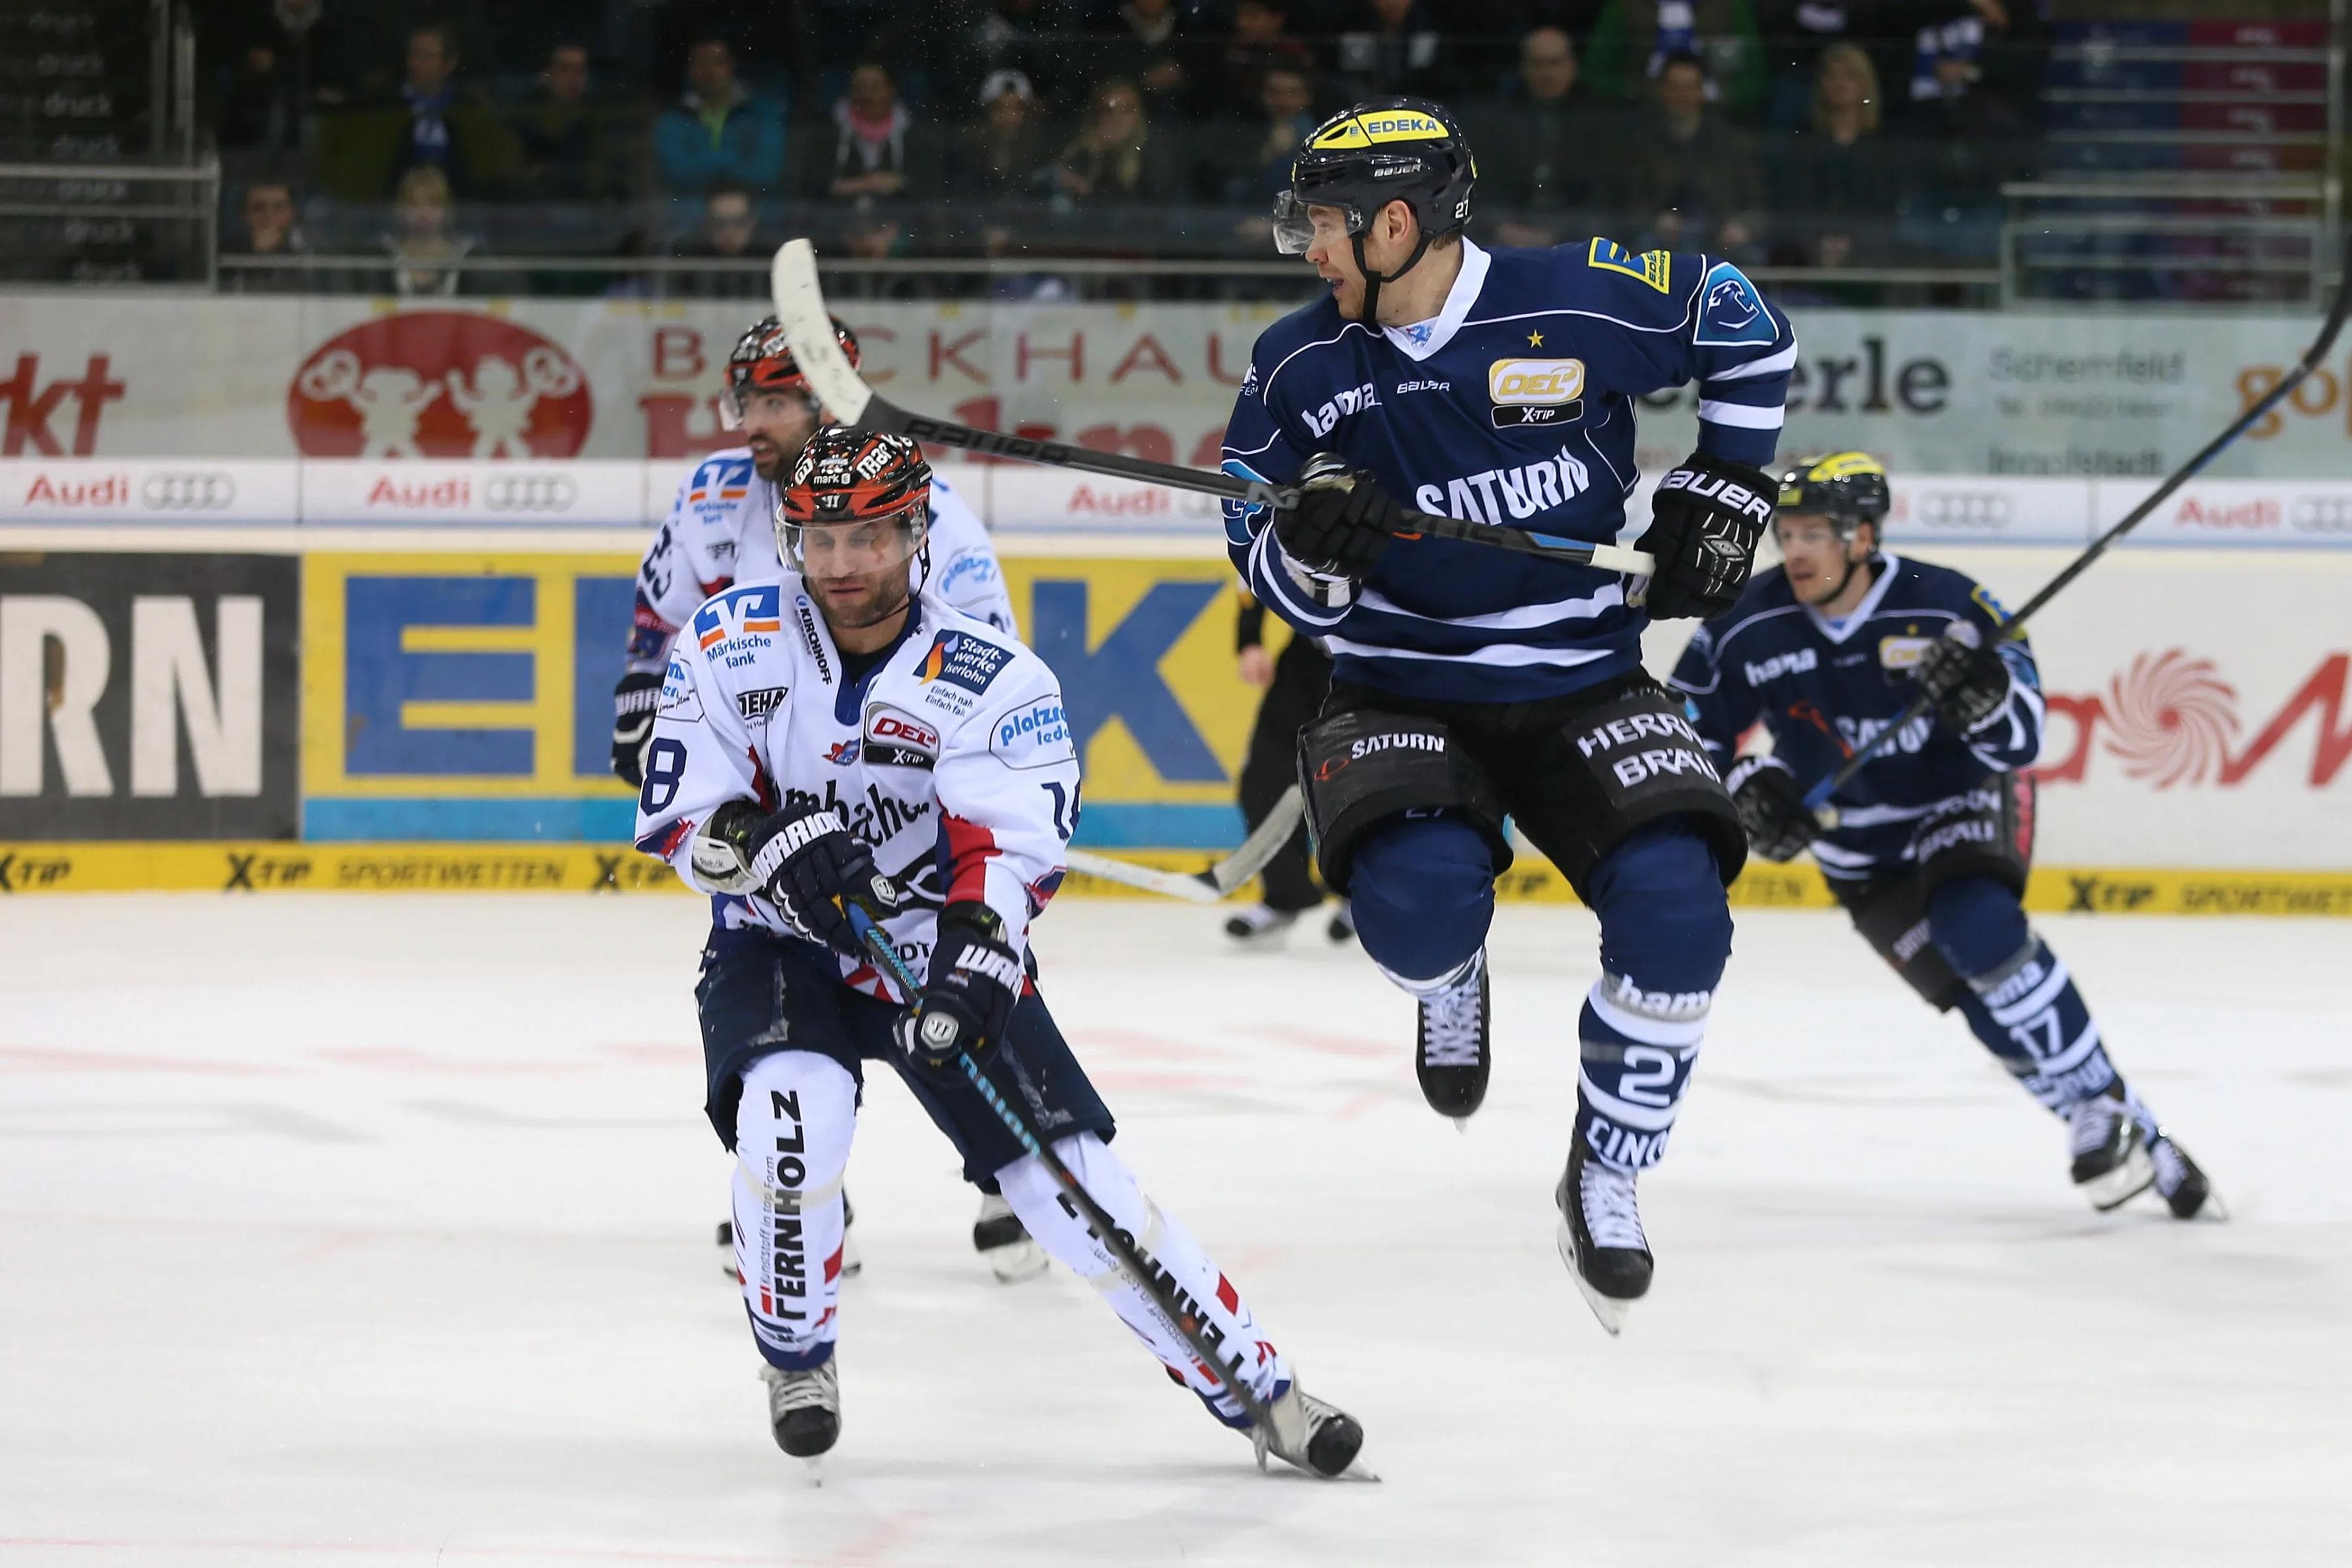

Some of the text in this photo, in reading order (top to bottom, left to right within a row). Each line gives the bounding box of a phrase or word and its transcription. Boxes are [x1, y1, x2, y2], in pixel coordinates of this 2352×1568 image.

[1368, 118, 1437, 134] EDEKA
[1454, 199, 1469, 220] 27
[1647, 252, 1657, 283] EDE
[655, 326, 1252, 383] BCKHAU
[1397, 380, 1450, 394] BAUER
[0, 353, 126, 457] kt
[1522, 406, 1556, 423] X-TIP
[25, 473, 127, 507] Audi
[368, 475, 470, 509] Audi
[813, 474, 840, 485] mark
[1416, 444, 1590, 527] SATURN
[1068, 483, 1169, 515] Audi
[2174, 497, 2280, 529] Audi
[706, 634, 772, 663] Märkische
[800, 607, 832, 685] KIRCHHOFF
[960, 638, 1002, 661] Stadt-
[944, 662, 987, 685] Iserlohn
[953, 652, 996, 674] werke
[0, 595, 264, 797] RN
[925, 694, 951, 711] Einfach
[930, 685, 956, 702] Einfach
[1351, 731, 1446, 761] SATURN
[337, 859, 568, 889] SPORTWETTEN
[1616, 972, 1712, 1014] ham
[764, 1155, 775, 1189] Form
